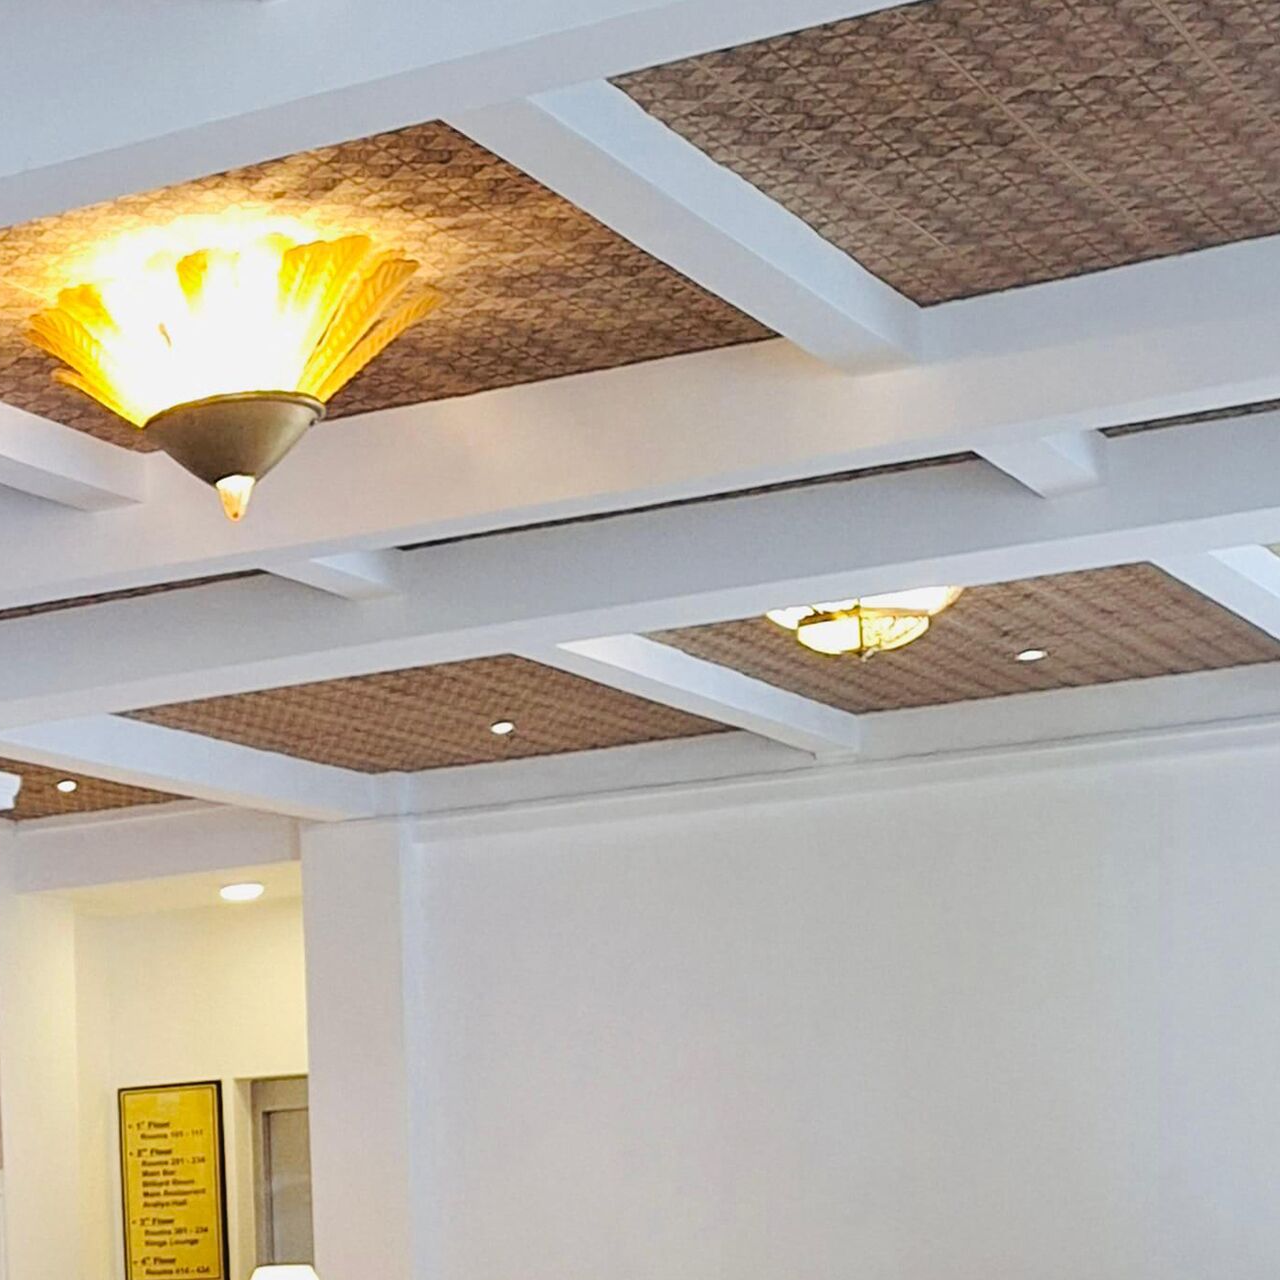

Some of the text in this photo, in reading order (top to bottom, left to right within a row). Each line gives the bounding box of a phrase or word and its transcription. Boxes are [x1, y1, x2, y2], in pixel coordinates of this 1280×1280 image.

[148, 1121, 170, 1129] Floor
[150, 1148, 173, 1157] Floor
[142, 1168, 175, 1177] Main Bar
[143, 1190, 161, 1198] Main
[152, 1217, 175, 1225] Floor
[153, 1256, 176, 1265] Floor
